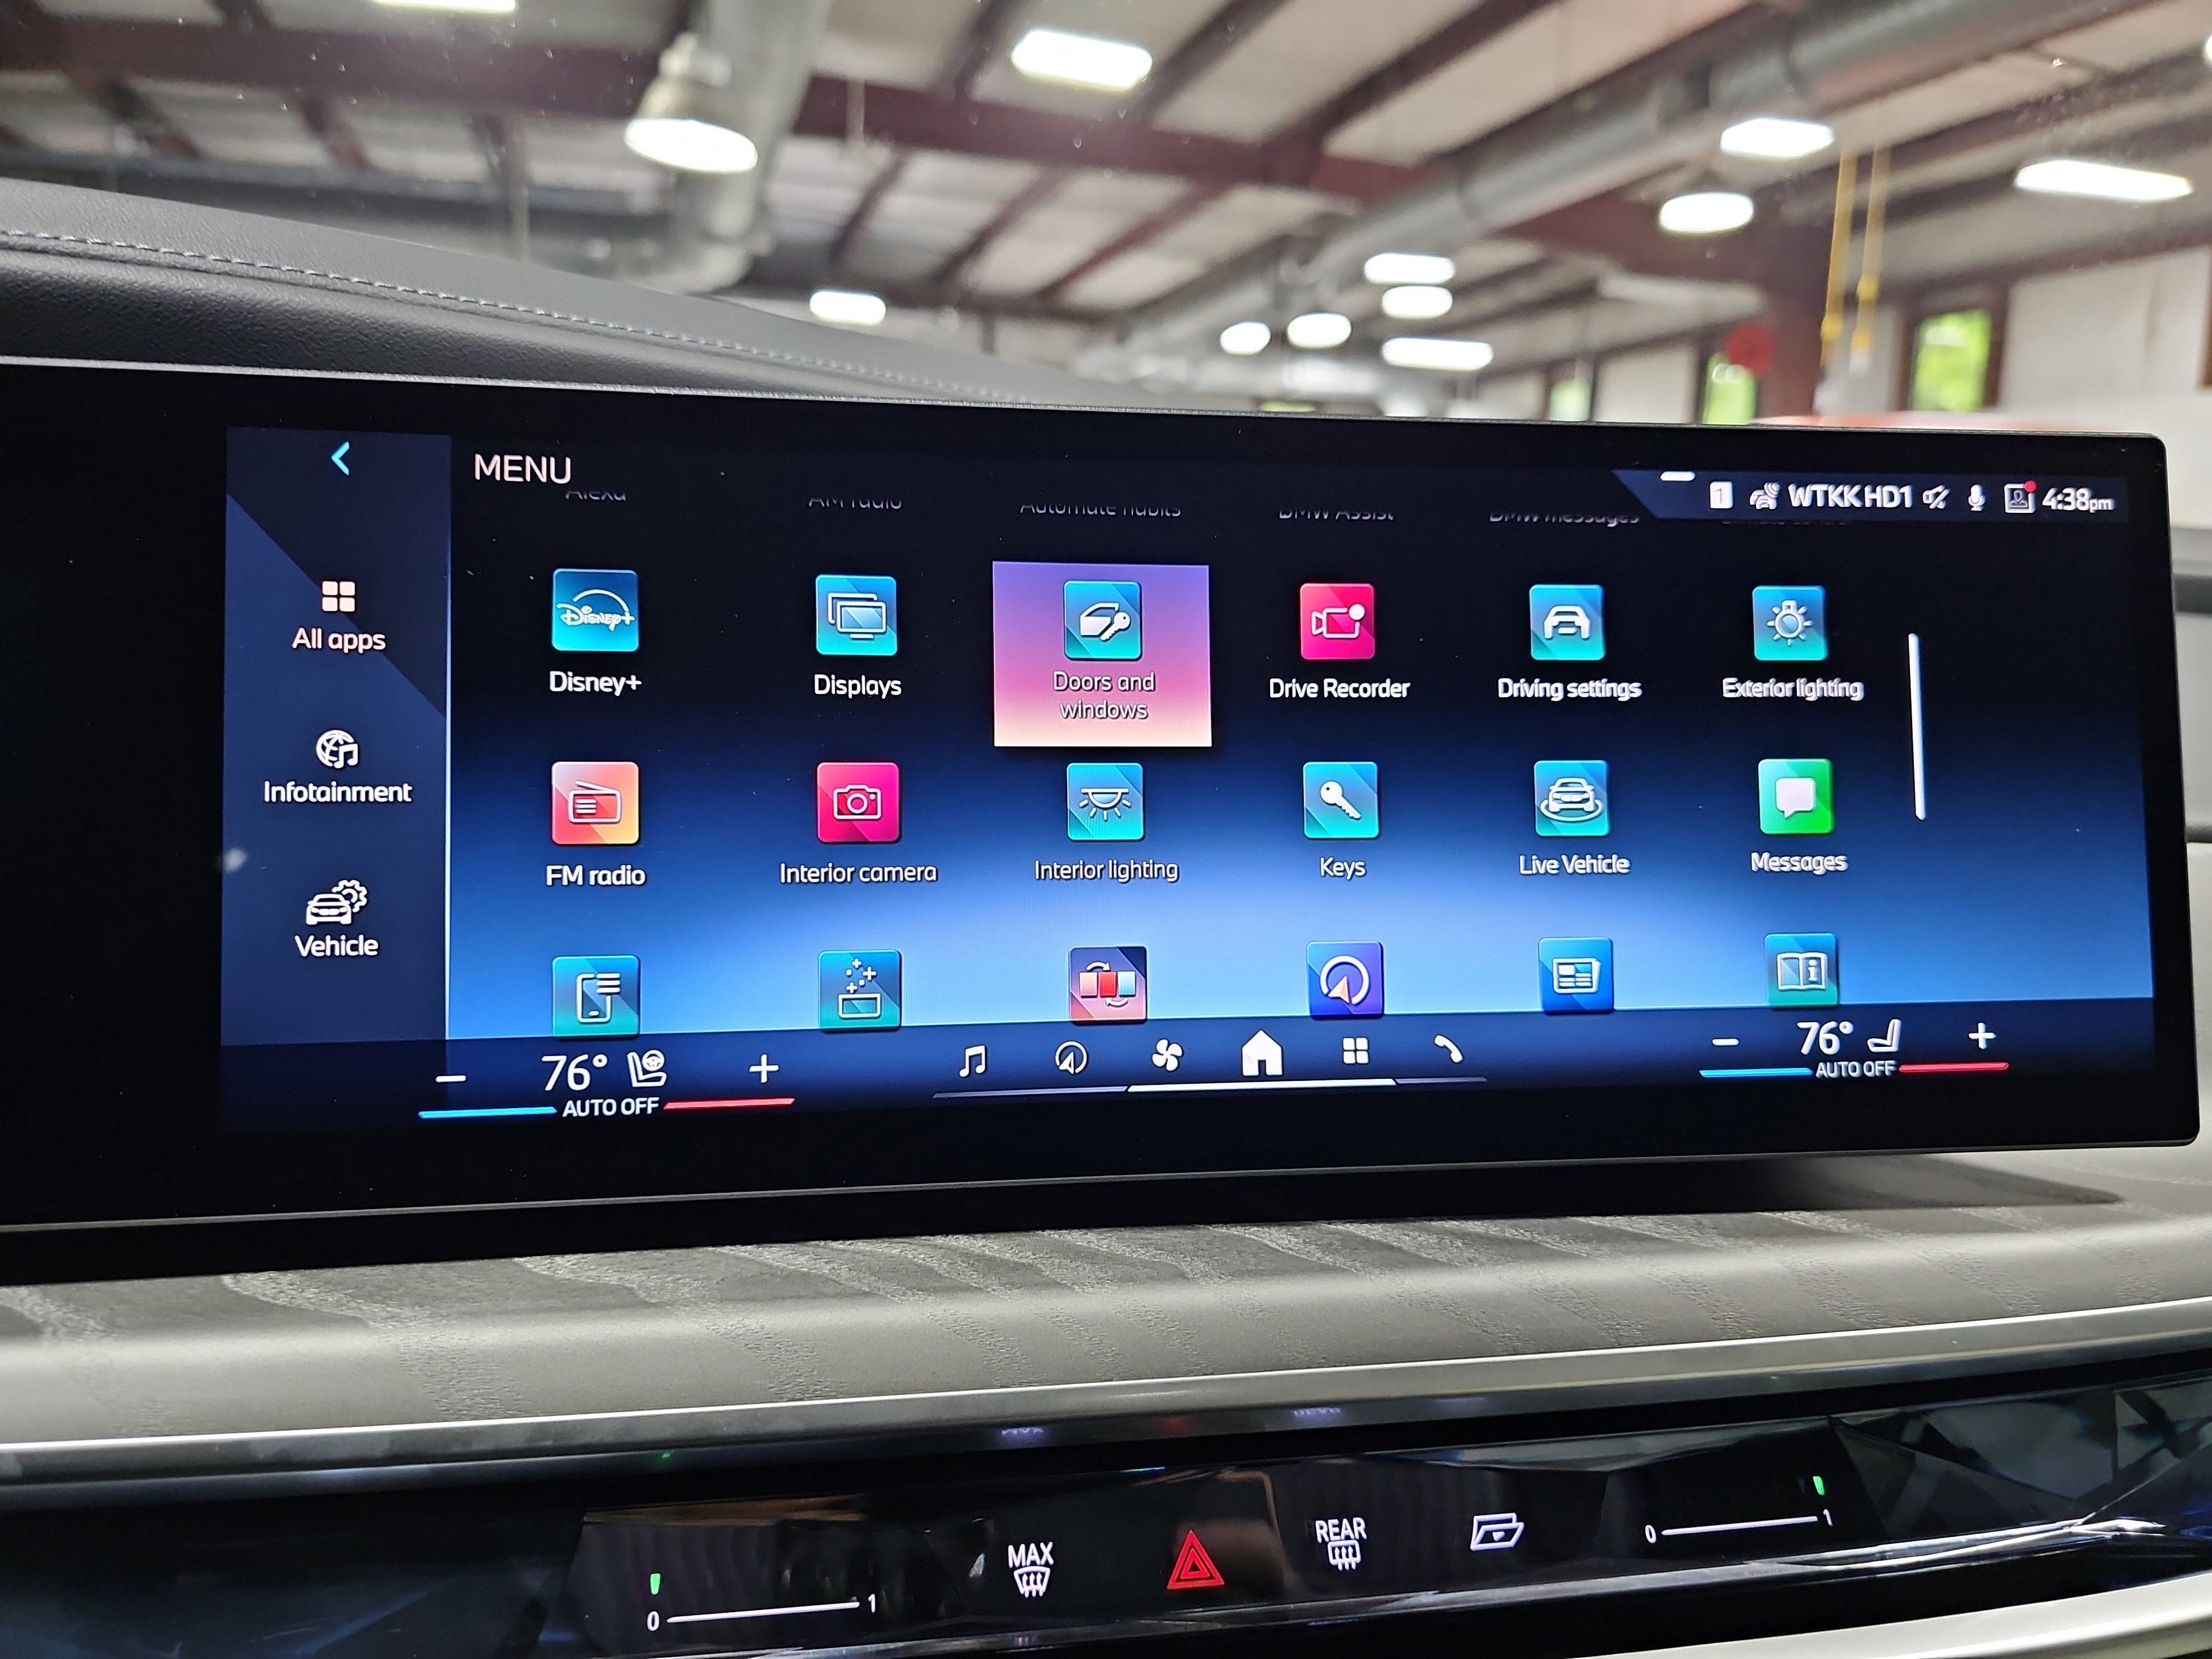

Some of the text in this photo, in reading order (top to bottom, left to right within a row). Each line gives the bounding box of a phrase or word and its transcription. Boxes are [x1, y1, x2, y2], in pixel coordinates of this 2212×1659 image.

[474, 453, 571, 485] MENU
[1787, 483, 1913, 509] WTKK HD1
[2041, 487, 2114, 514] 4:38pm
[555, 602, 636, 632] Disney+
[291, 627, 387, 654] All apps
[549, 670, 643, 697] Disney+
[814, 673, 902, 700] Displays
[1053, 670, 1154, 691] Doors and
[1269, 677, 1412, 699] Drive Recorder
[1497, 677, 1643, 702] Driving settings
[1722, 677, 1864, 702] Exterior lighting
[1059, 700, 1149, 720] windows
[263, 780, 413, 803] Infotainment
[546, 864, 646, 886] FM radio
[780, 862, 936, 883] Interior camera
[1035, 858, 1178, 883] Interior lighting
[1320, 857, 1366, 880] Keys
[1519, 854, 1630, 874] Live Vehicle
[1751, 852, 1847, 876] Messages
[294, 934, 379, 957] Vehicle
[1796, 1020, 1854, 1055] 76°
[541, 1053, 608, 1091] 76°
[1815, 1059, 1895, 1078] AUTO OFF
[562, 1096, 660, 1118] AUTO OFF
[1314, 1516, 1368, 1542] REAR
[1006, 1541, 1054, 1567] MAX
